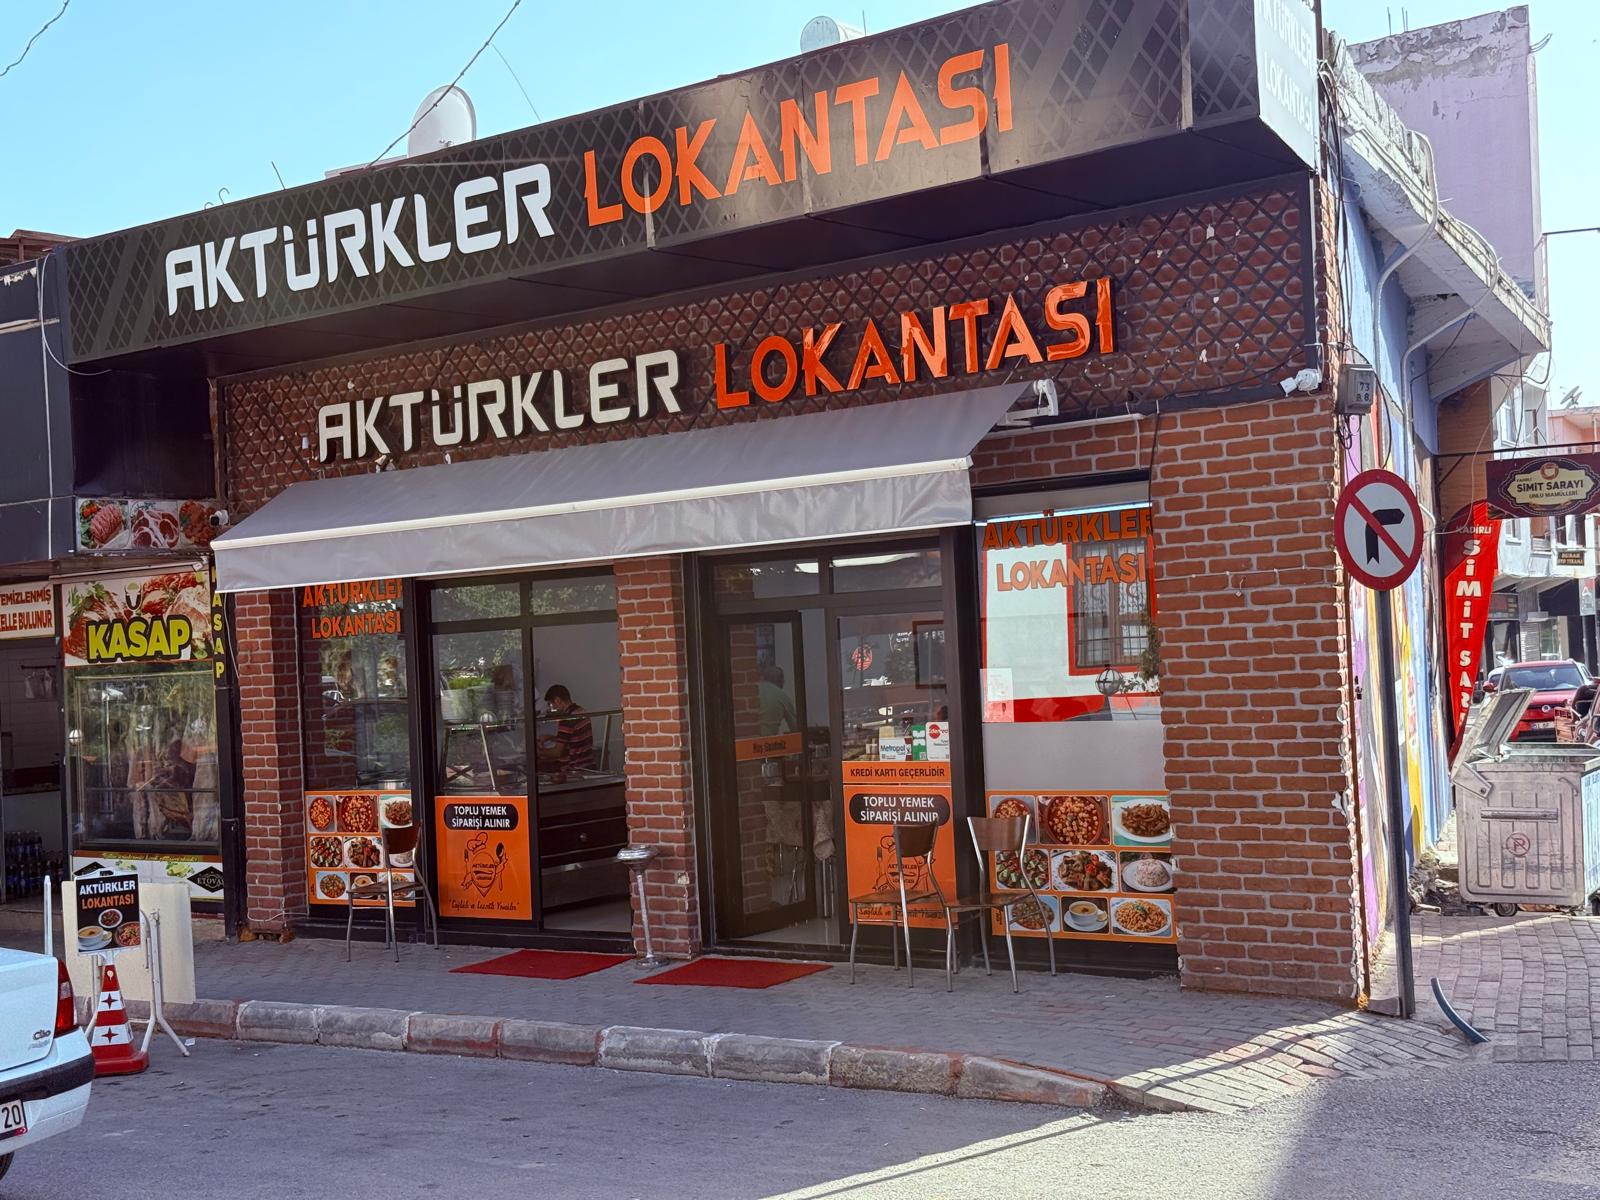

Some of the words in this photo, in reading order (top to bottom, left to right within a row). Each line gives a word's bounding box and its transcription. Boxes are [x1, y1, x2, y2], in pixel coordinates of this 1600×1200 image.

[1264, 51, 1314, 136] LOKANTASI
[164, 162, 556, 317] AKTÜRKLER
[583, 42, 1013, 227] LOKANTASI
[317, 348, 681, 463] AKTÜRKLER
[713, 277, 1115, 409] LOKANTASI
[1546, 479, 1584, 491] SARAYI
[996, 552, 1146, 592] LOKANTASI
[0, 587, 52, 605] EMİZLENMİŞ
[0, 612, 17, 632] ELLE
[18, 610, 53, 630] BULUNUR
[312, 611, 401, 639] LOKANTASI
[88, 618, 191, 660] KASAP
[880, 744, 906, 752] Metropol
[850, 766, 873, 777] KREDİ
[874, 768, 897, 777] KARTI
[898, 766, 945, 779] GEÇERLİDİR
[454, 805, 479, 816] TOPLU
[481, 806, 507, 816] YEMEK
[863, 796, 896, 808] TOPLU
[900, 797, 935, 808] YEMEK
[452, 815, 482, 830] SİPARİŞİ
[484, 817, 511, 828] ALINIR
[860, 808, 901, 824] SİPARİŞİ
[79, 880, 136, 896] AKTÜRKLER
[81, 894, 134, 910] LOKANTASI
[1, 1104, 21, 1129] 20
